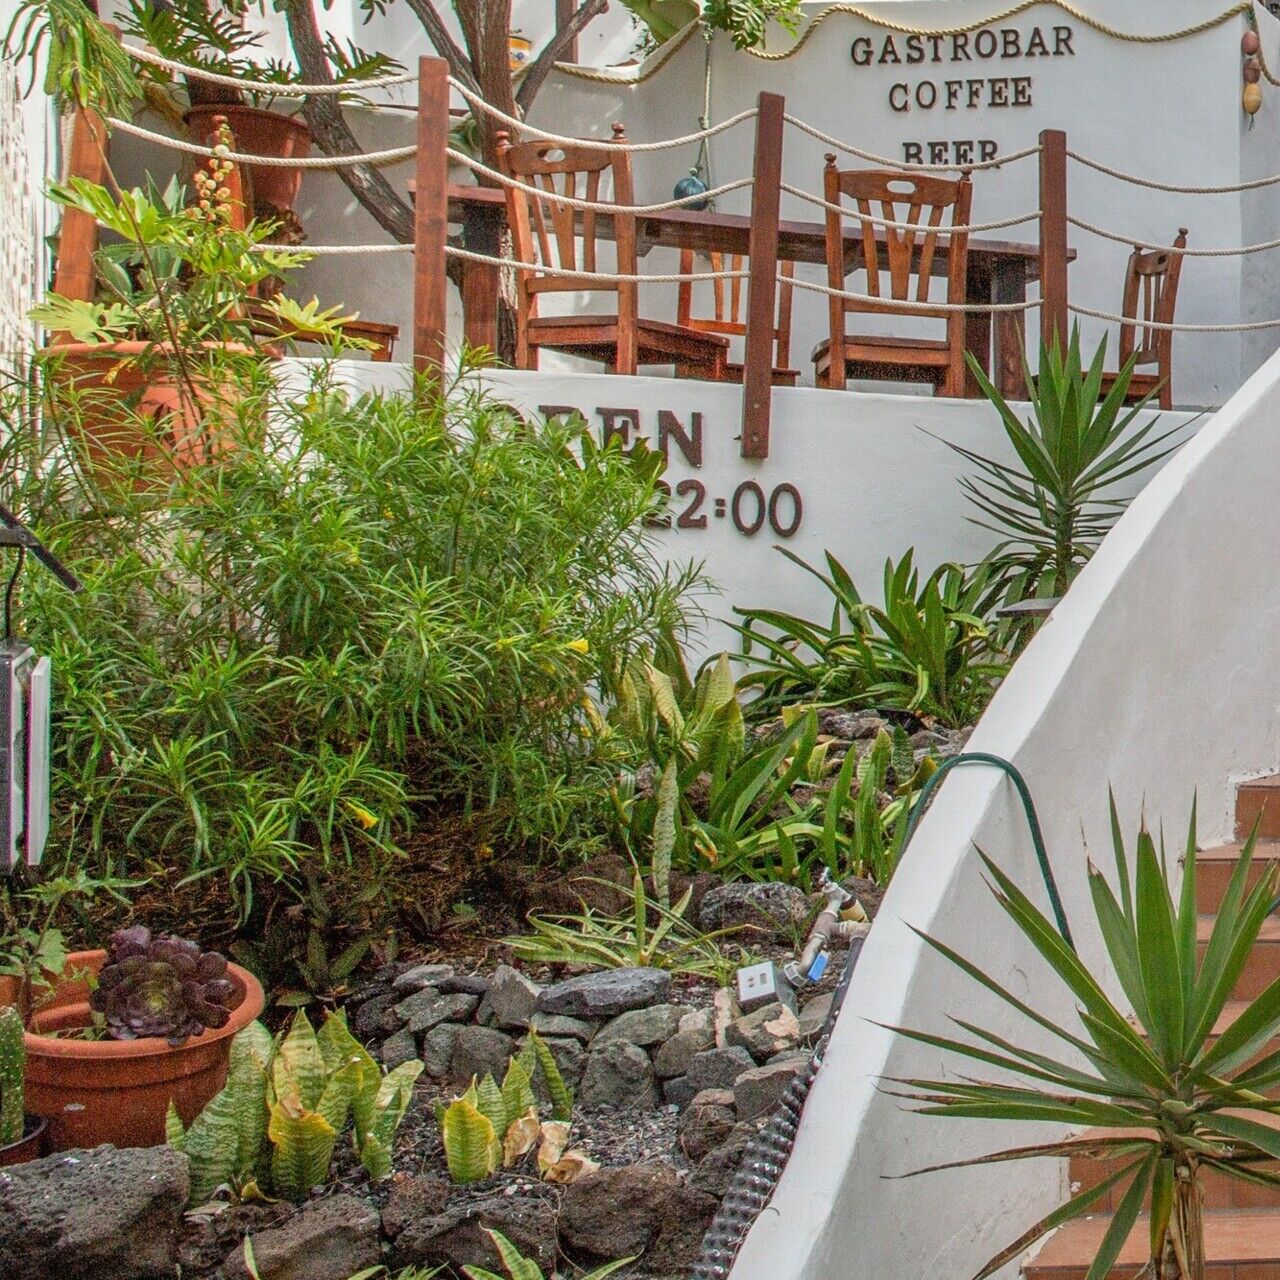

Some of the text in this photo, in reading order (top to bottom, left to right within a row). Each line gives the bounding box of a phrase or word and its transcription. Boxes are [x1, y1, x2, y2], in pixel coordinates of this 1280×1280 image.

[851, 25, 1076, 66] GASTROBAR
[888, 76, 1033, 112] COFFEE
[902, 139, 1001, 169] BEER
